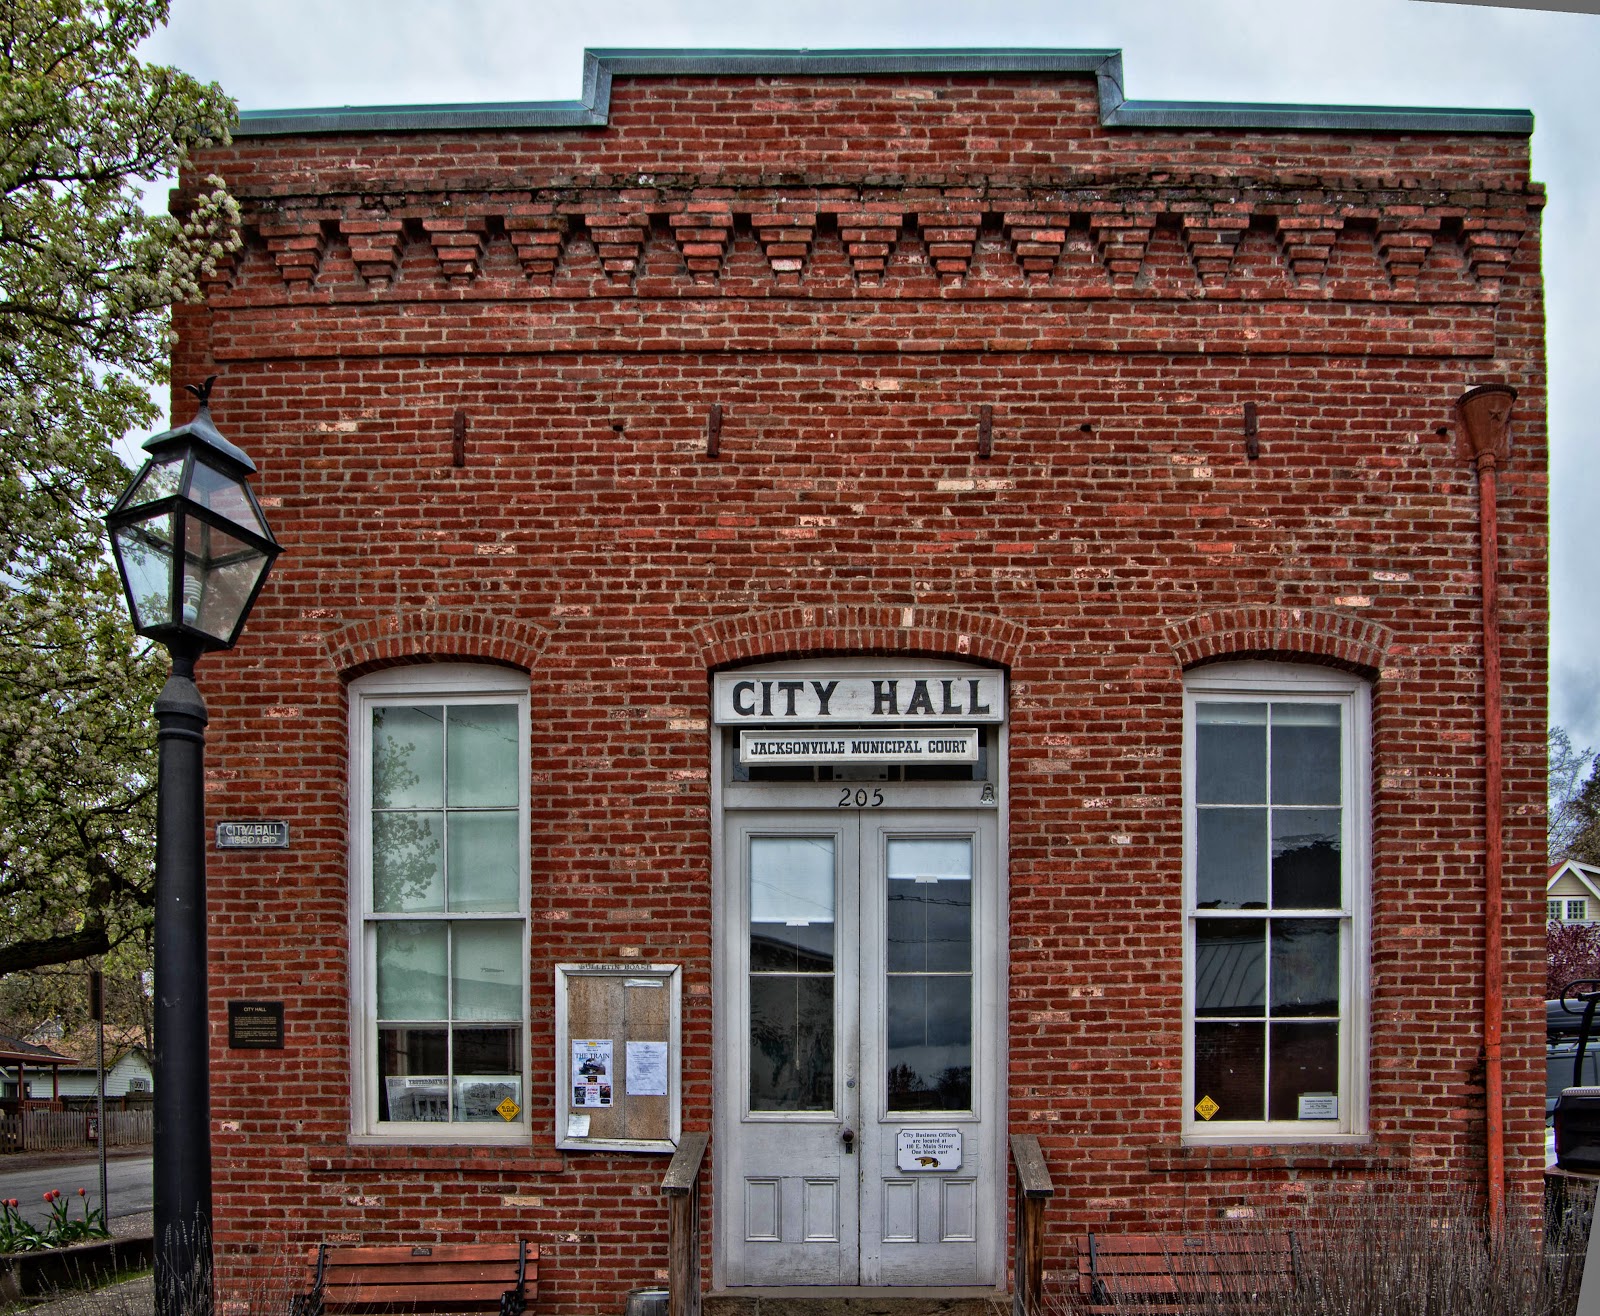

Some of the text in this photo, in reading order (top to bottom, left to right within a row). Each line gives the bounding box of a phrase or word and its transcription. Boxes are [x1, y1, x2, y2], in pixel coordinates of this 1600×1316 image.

[732, 680, 990, 716] CITY HALL
[751, 740, 967, 755] JACKSONVILLE MUNICIPAL COURT
[838, 787, 884, 807] 205
